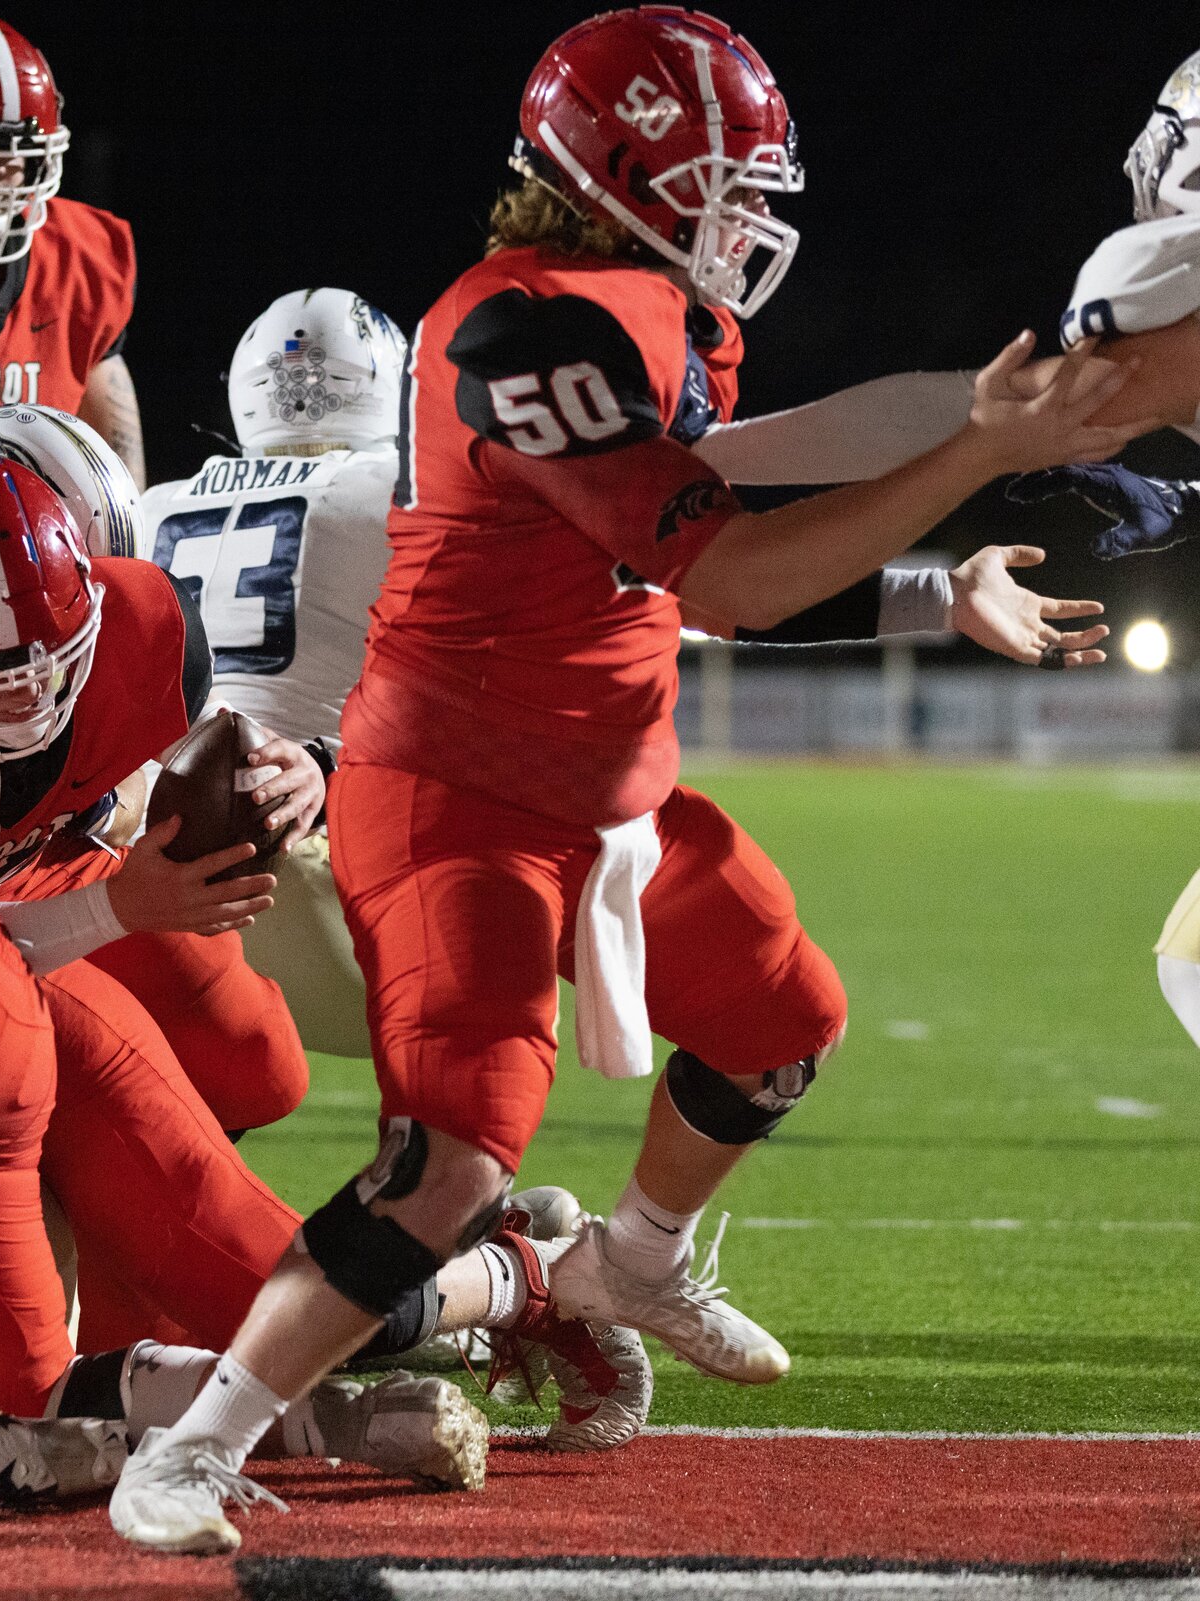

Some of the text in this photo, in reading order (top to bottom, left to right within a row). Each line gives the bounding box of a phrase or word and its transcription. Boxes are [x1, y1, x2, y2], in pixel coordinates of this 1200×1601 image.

[614, 74, 686, 141] 50
[487, 361, 631, 457] 50
[190, 459, 320, 496] NORMAN
